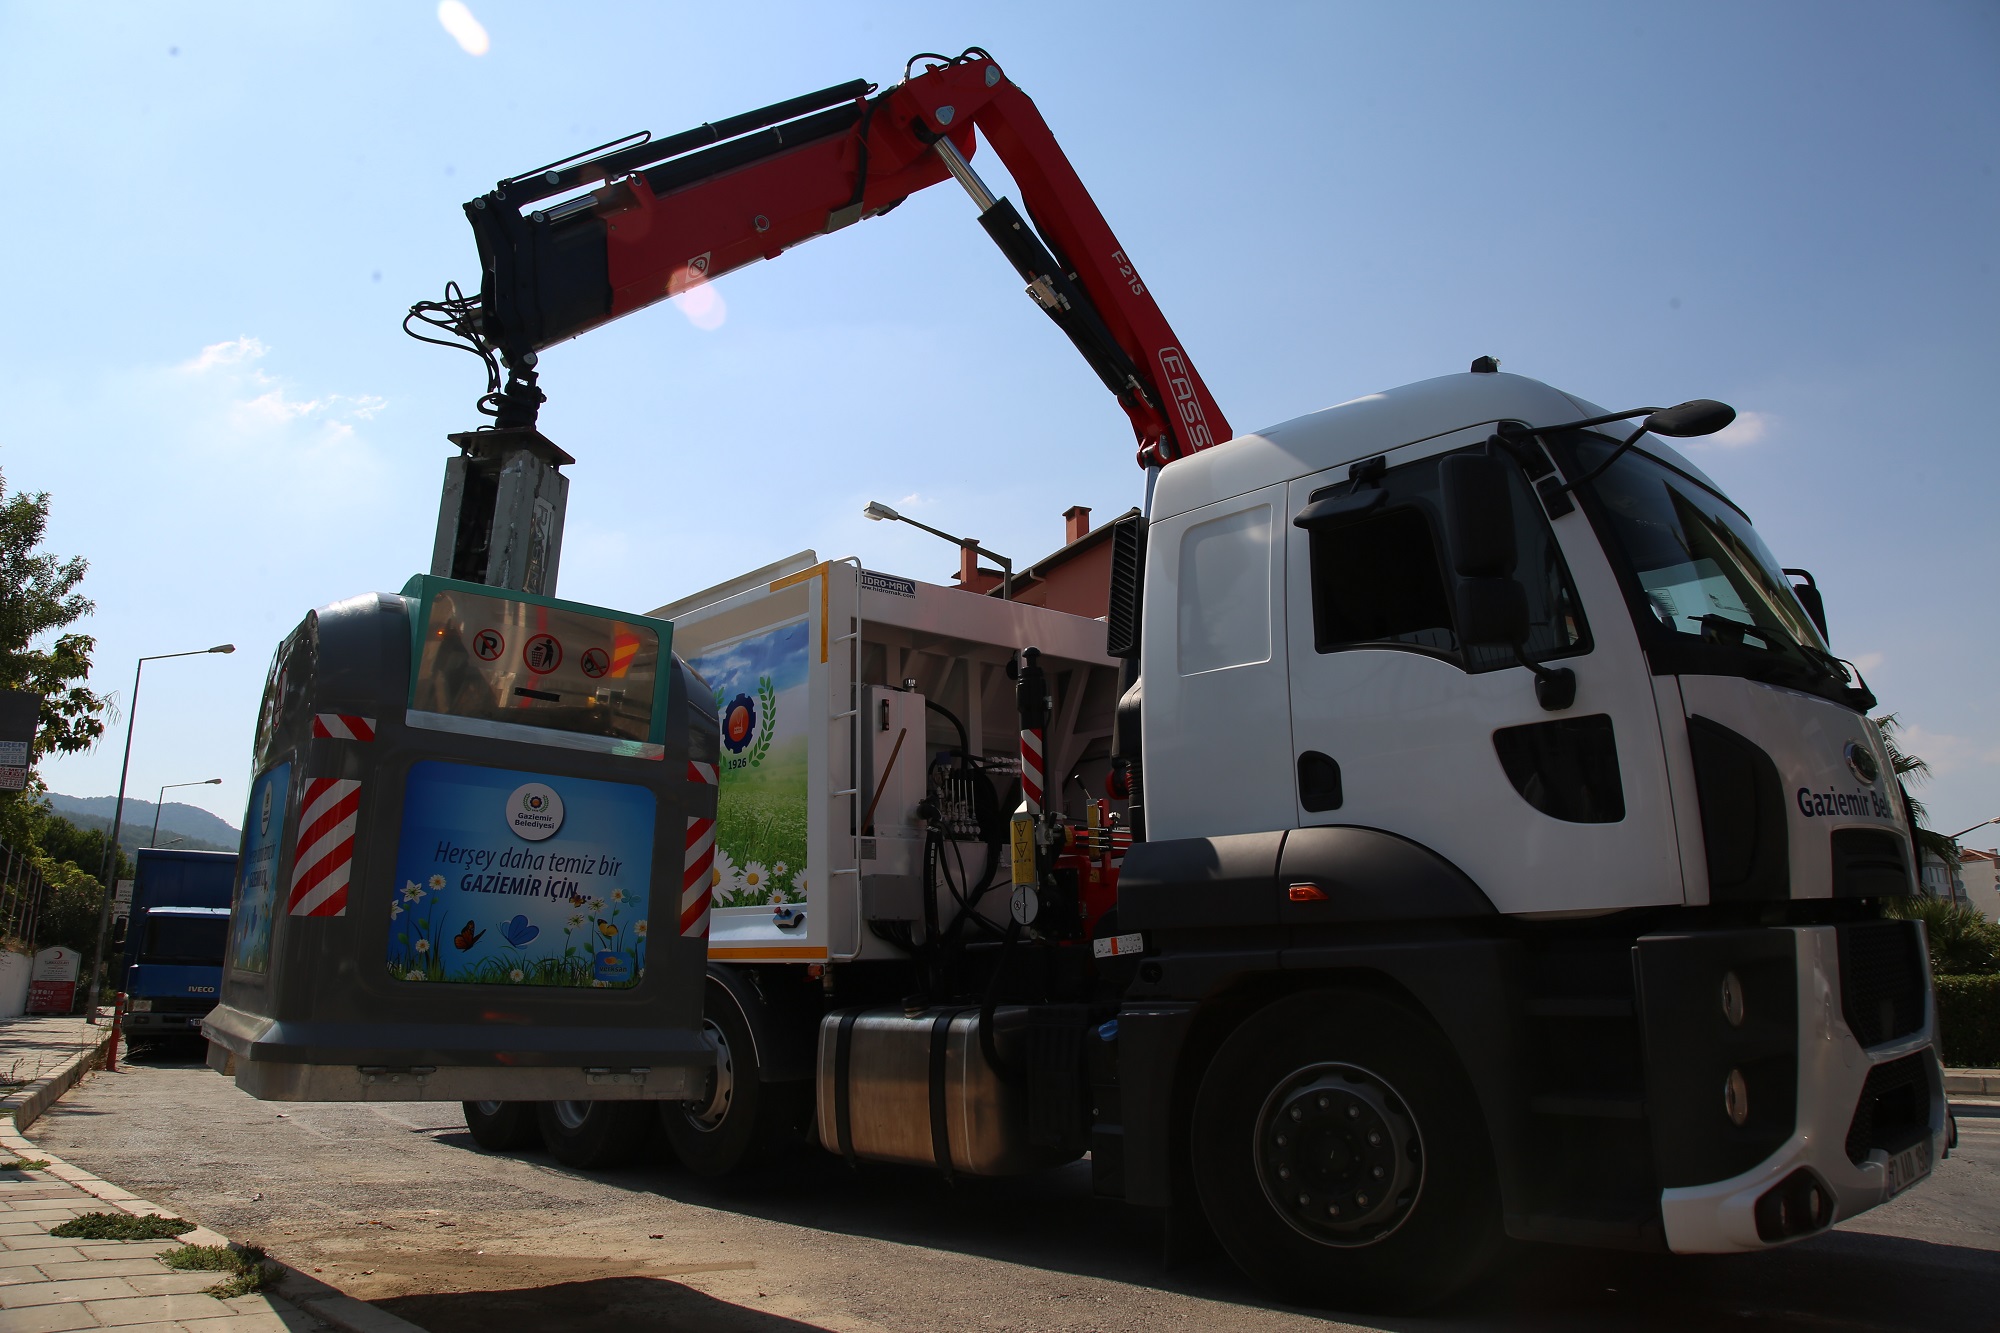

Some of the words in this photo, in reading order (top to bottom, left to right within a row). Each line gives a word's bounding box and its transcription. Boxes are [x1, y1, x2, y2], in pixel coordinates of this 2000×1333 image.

[1111, 250, 1145, 296] F215
[728, 758, 747, 770] 1926
[1797, 785, 1869, 818] Gaziemir
[514, 819, 555, 830] Belediyesi
[517, 812, 553, 822] Gaziemir
[434, 841, 497, 871] Herşey
[499, 847, 545, 871] daha
[548, 852, 596, 875] temiz
[598, 855, 622, 877] bir
[460, 872, 542, 897] GAZİEMİR
[188, 985, 215, 993] IVECO
